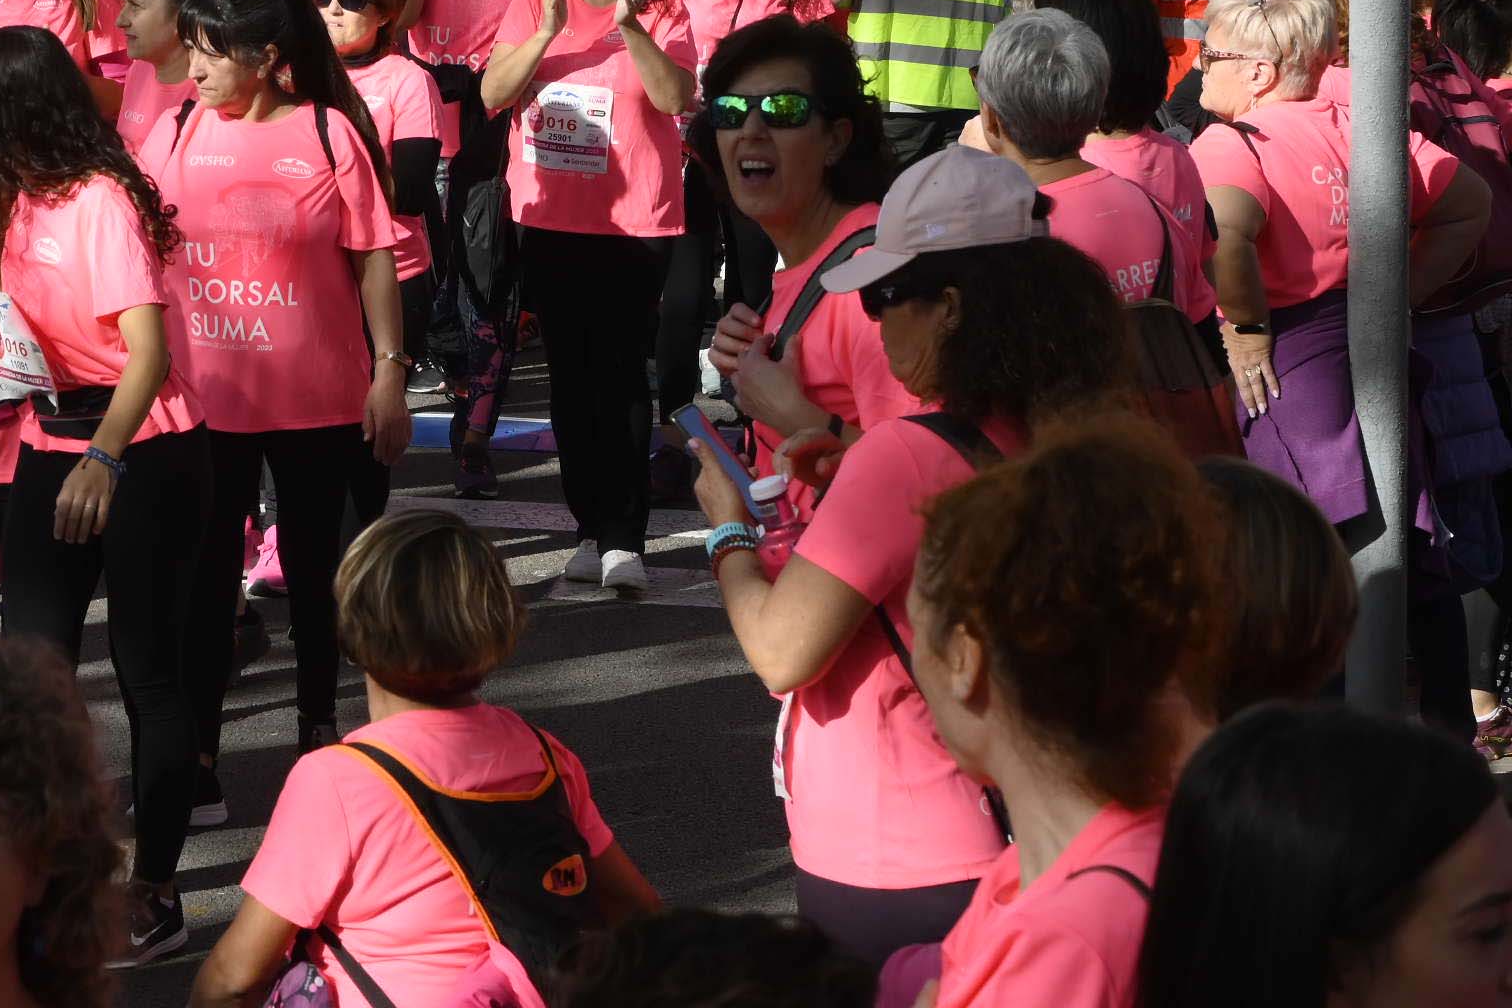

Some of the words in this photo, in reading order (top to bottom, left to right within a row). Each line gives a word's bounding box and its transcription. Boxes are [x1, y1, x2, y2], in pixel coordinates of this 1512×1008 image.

[427, 25, 450, 45] TU
[546, 117, 577, 131] 016
[190, 155, 235, 167] OYSHO
[186, 242, 215, 267] TU
[188, 278, 298, 306] DORSAL
[191, 312, 270, 342] SUMA
[5, 338, 28, 357] 016
